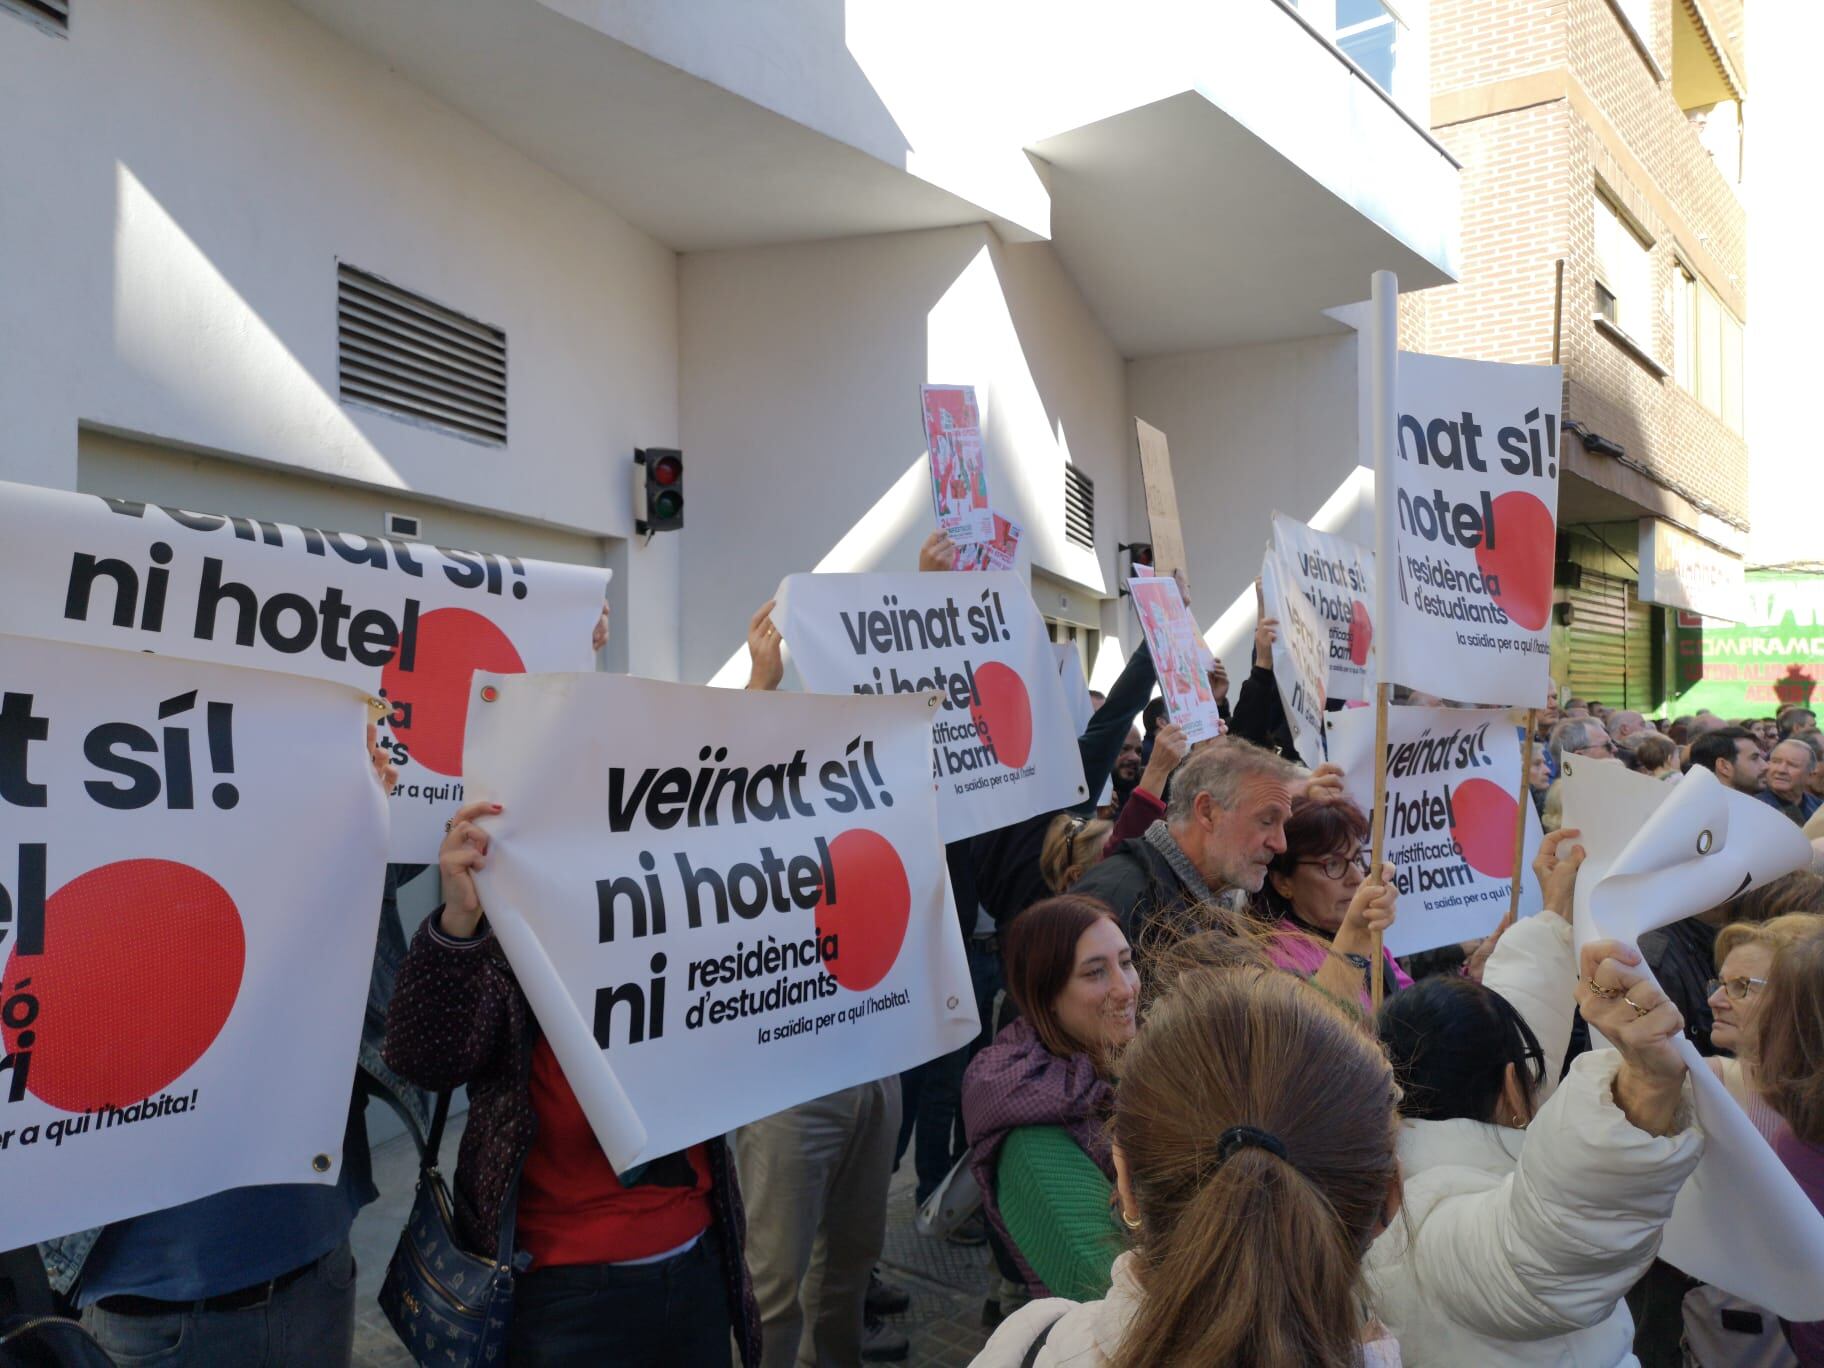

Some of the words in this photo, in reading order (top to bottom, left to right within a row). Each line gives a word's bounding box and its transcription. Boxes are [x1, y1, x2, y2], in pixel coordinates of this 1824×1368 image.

[1398, 411, 1488, 472] nat
[1497, 407, 1556, 479] sí!
[1298, 549, 1347, 588] veïnat
[1348, 561, 1366, 592] sí!
[1407, 555, 1500, 596] residència
[65, 541, 174, 632] ni
[194, 556, 420, 672] hotel
[840, 595, 966, 655] veïnat
[968, 588, 1010, 644] sí!
[1318, 589, 1355, 624] hotel
[1414, 584, 1508, 625] d'estudiants
[1456, 632, 1466, 644] la
[1497, 638, 1512, 653] per
[83, 689, 240, 810] sí!
[932, 714, 988, 745] tificació
[943, 735, 998, 775] barri
[1386, 728, 1460, 778] veïnat
[1455, 722, 1492, 770] sí!
[423, 784, 449, 804] qui
[608, 745, 816, 832] veïnat
[818, 735, 894, 814] sí!
[954, 784, 964, 794] la
[990, 774, 1002, 789] per
[1391, 784, 1456, 838] hotel
[595, 850, 667, 944] ni
[674, 836, 837, 929] hotel
[1418, 856, 1474, 892] barri
[1424, 900, 1433, 912] la
[1434, 896, 1463, 910] saïdia
[1464, 894, 1480, 908] per
[1490, 888, 1506, 902] qui
[593, 952, 668, 1050] ni
[688, 927, 839, 991] residència
[686, 972, 838, 1030] d'estudiants
[758, 1028, 770, 1044] la
[774, 1016, 813, 1040] saïdia
[816, 1013, 836, 1035] per
[838, 1011, 846, 1023] a
[848, 1001, 865, 1024] qui
[866, 988, 910, 1015] l'habita!
[20, 1125, 40, 1146] a
[46, 1108, 92, 1146] qui
[96, 1088, 198, 1130] l'habita!
